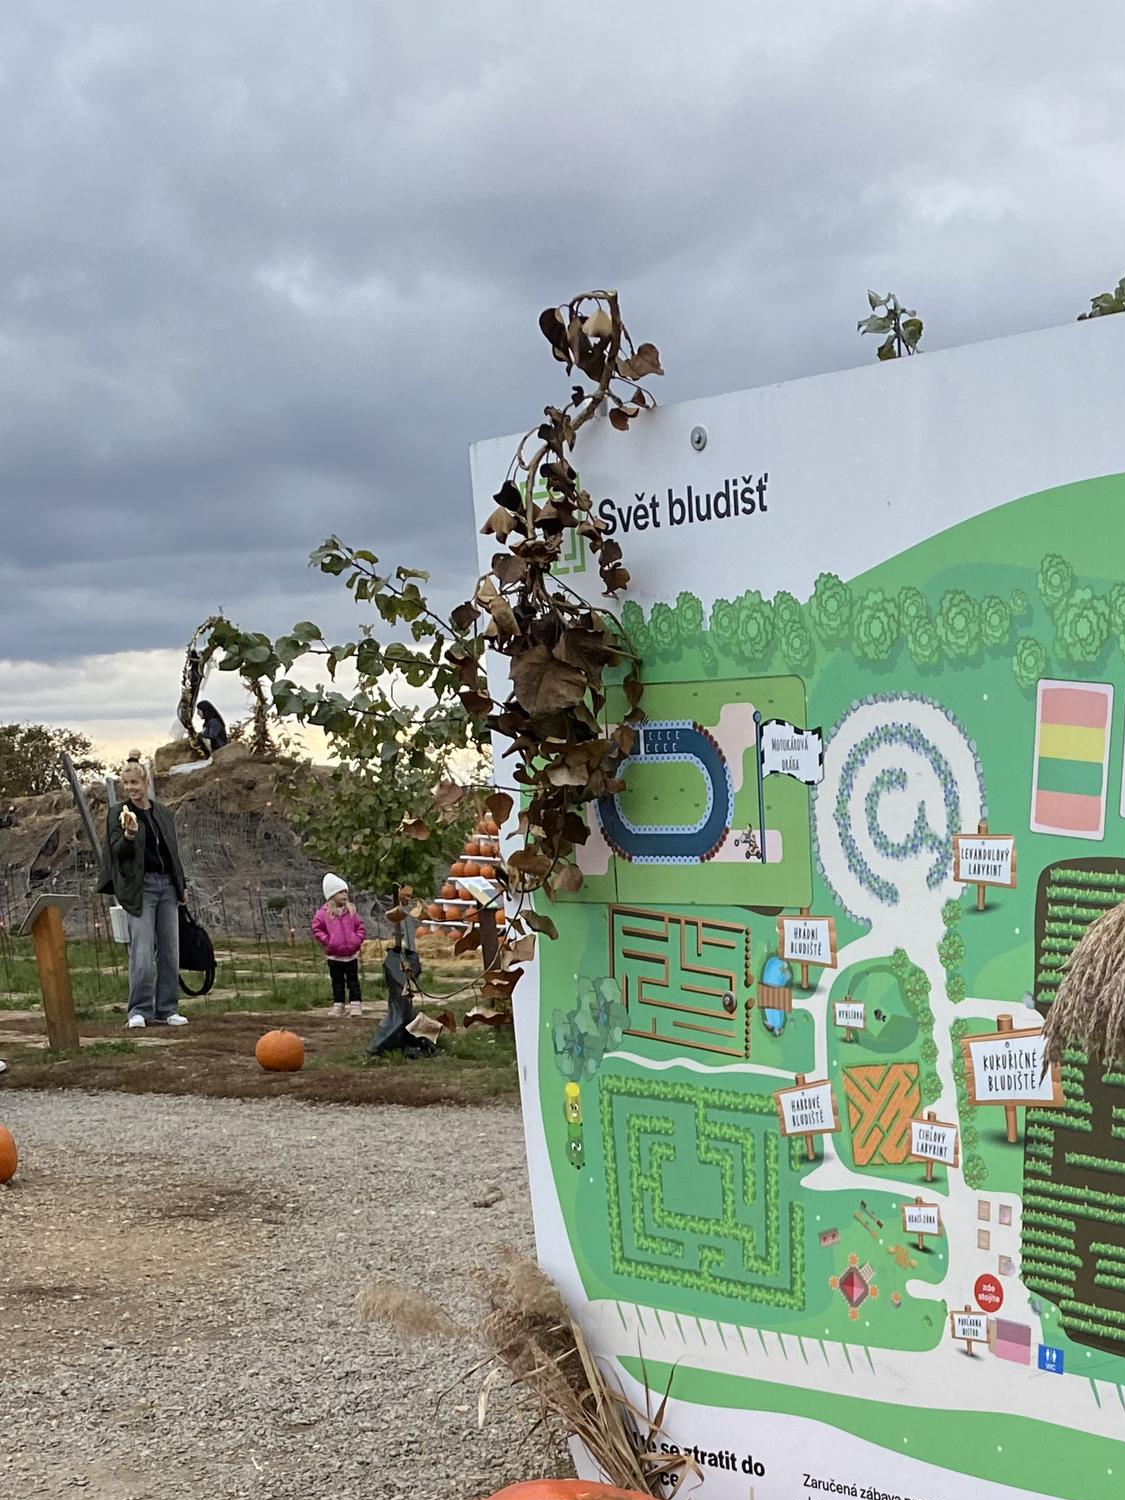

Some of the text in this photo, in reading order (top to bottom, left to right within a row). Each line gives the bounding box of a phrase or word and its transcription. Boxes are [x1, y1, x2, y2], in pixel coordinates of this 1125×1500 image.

[598, 472, 769, 535] Svět bludišť
[961, 848, 1010, 862] LEVANDULOVÝ
[968, 863, 1002, 877] LABYRINT
[790, 941, 822, 956] BLUDIŠTĚ
[983, 1049, 1037, 1071] KUKUŘIČNÉ
[988, 1070, 1036, 1092] BLUDIŠTĚ
[792, 1109, 824, 1127] BLUDIŠTĚ
[916, 1141, 948, 1158] LABYRINT
[982, 1284, 996, 1293] zde
[1045, 1362, 1057, 1371] WC
[741, 1455, 766, 1477] do
[803, 1473, 858, 1497] Zaručená
